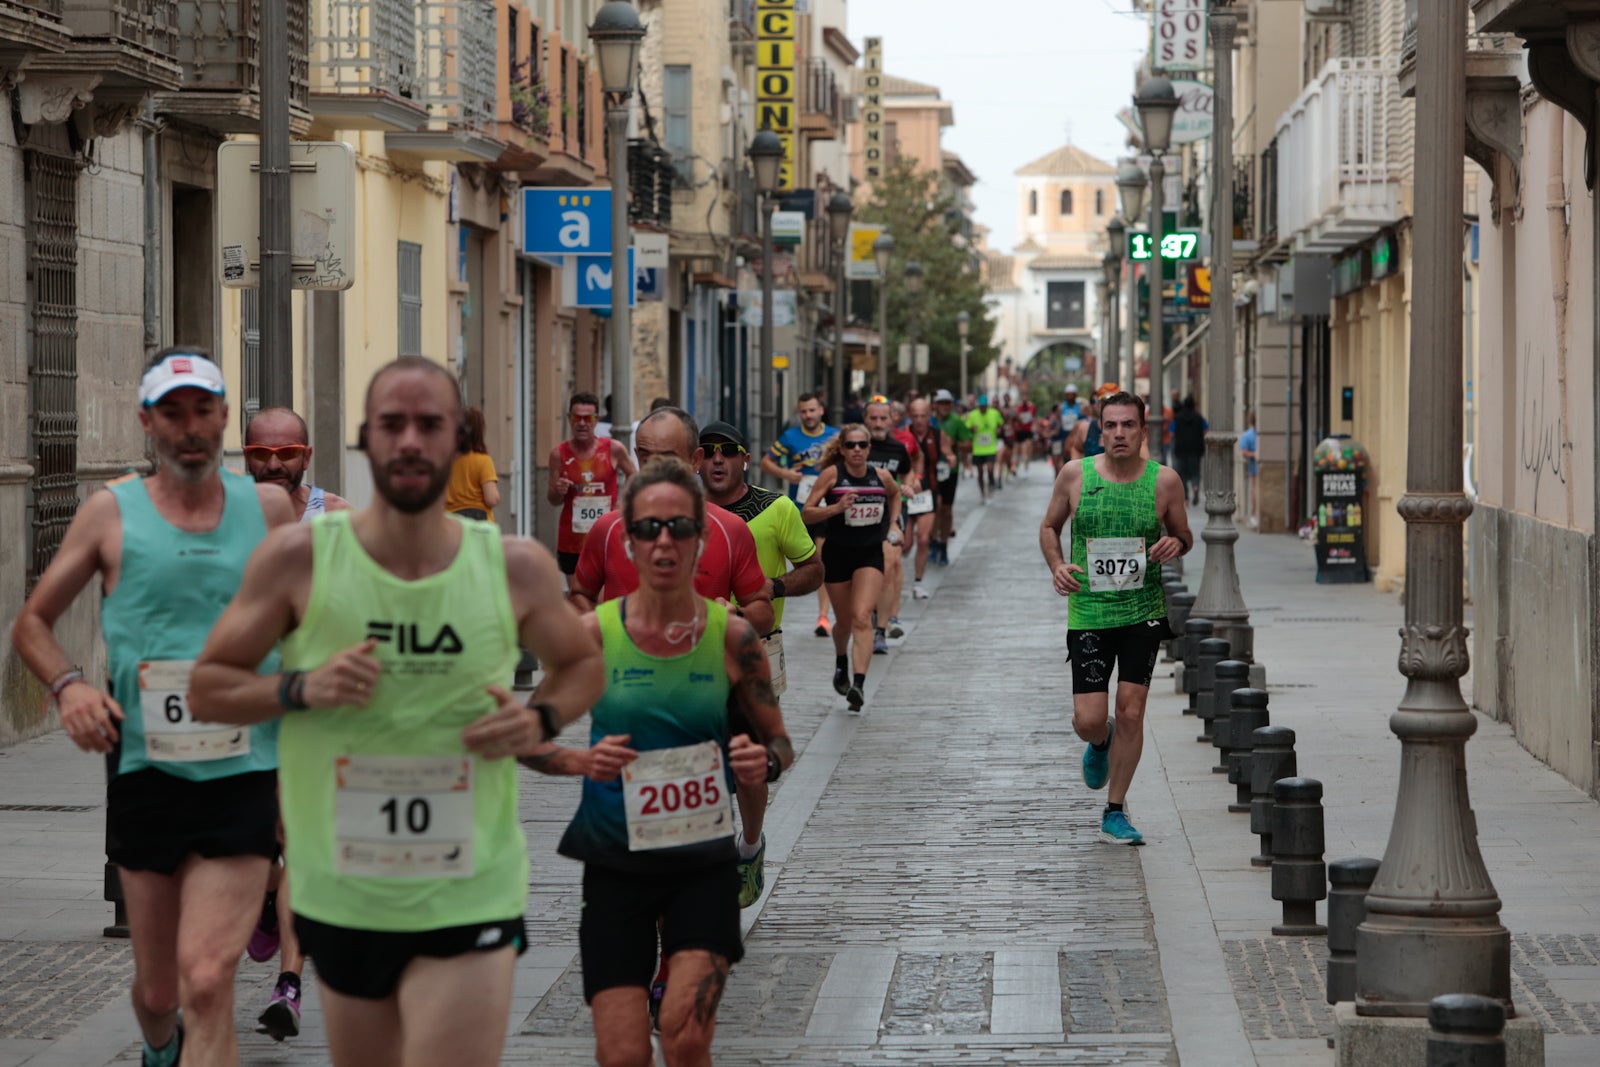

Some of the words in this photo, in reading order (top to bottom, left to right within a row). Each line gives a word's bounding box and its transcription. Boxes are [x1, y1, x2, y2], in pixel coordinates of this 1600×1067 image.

[762, 0, 789, 187] CION
[867, 38, 880, 177] PIONONOS
[581, 508, 604, 520] 505
[850, 506, 880, 519] 2125
[1094, 558, 1139, 575] 3079
[367, 621, 464, 655] FILA
[639, 775, 720, 816] 2085
[380, 797, 431, 835] 10
